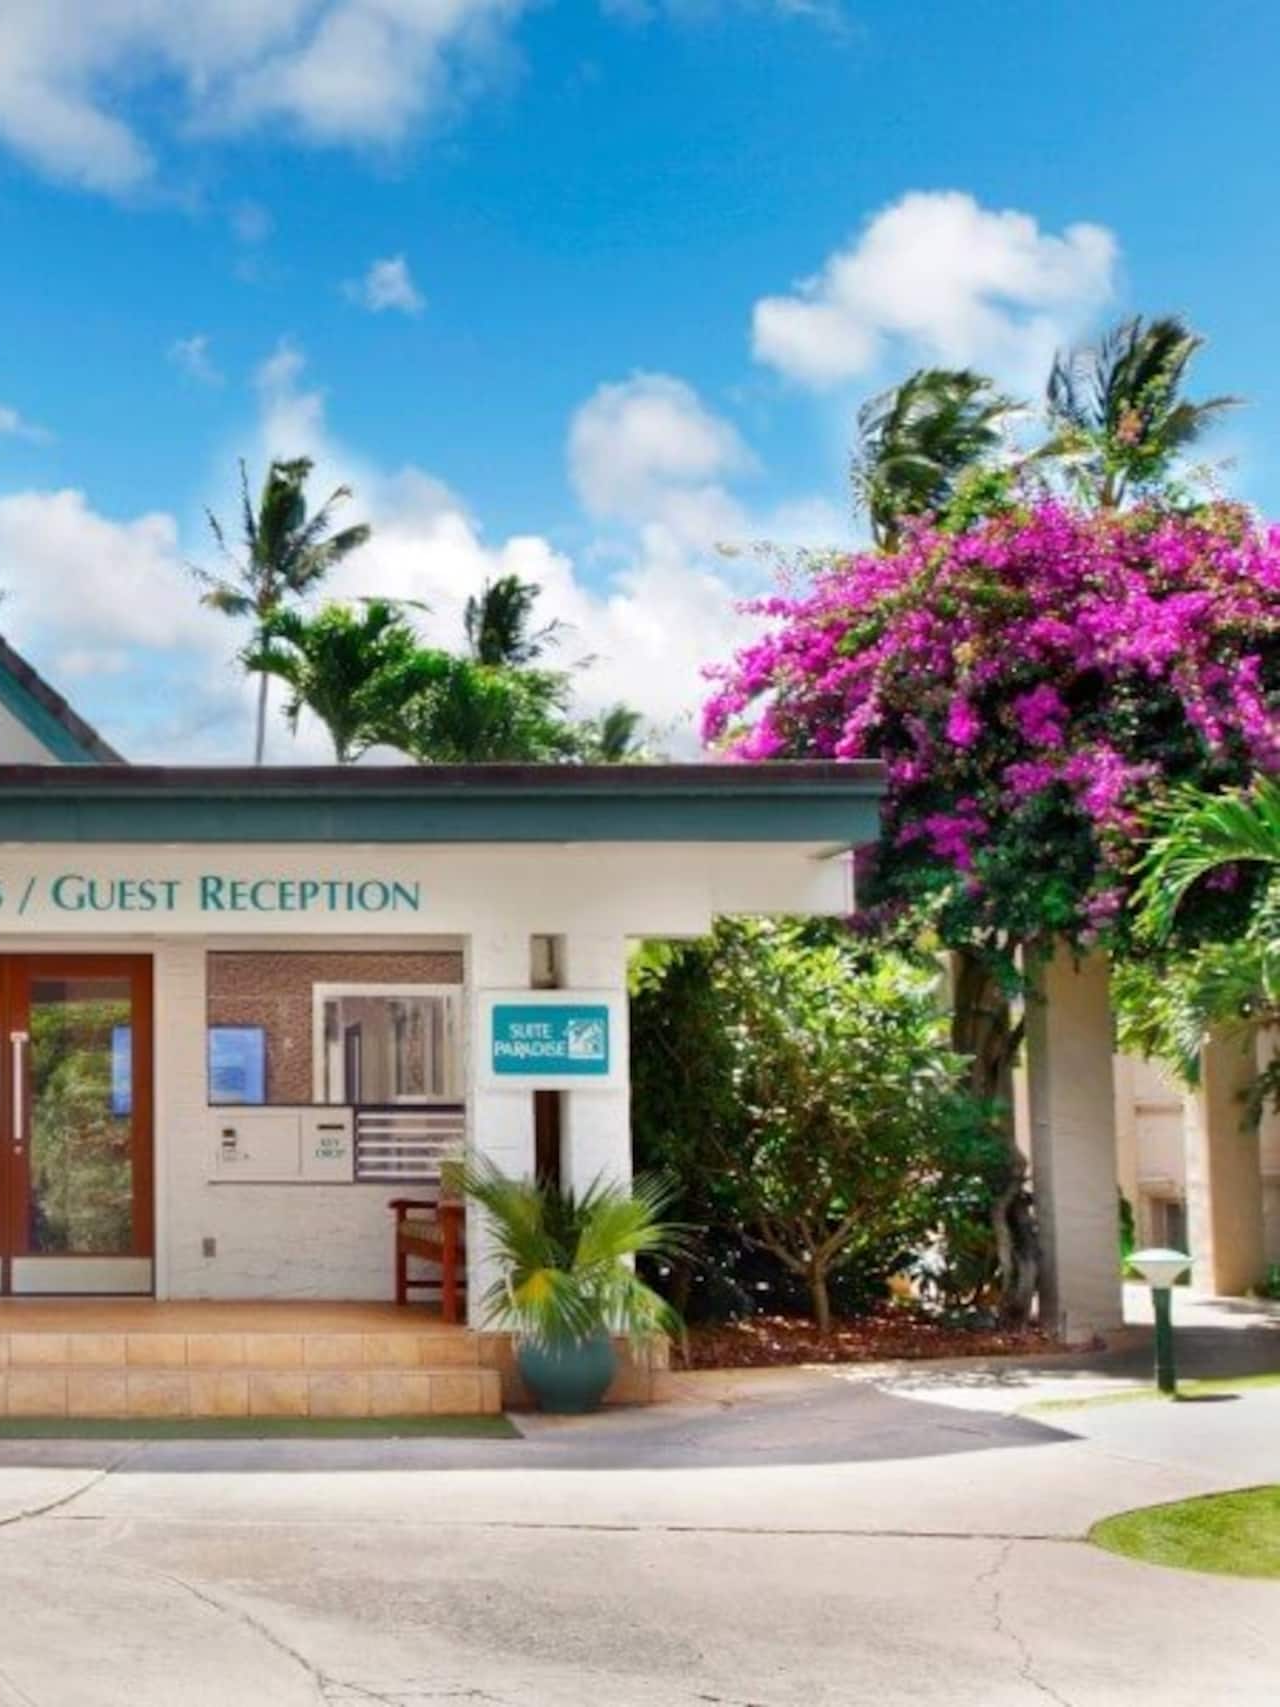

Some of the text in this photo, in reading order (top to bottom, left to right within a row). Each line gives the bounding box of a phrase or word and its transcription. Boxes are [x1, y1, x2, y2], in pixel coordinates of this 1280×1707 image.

[51, 875, 181, 911] GUEST
[200, 876, 421, 911] RECEPTION
[509, 1023, 552, 1040] SUITE
